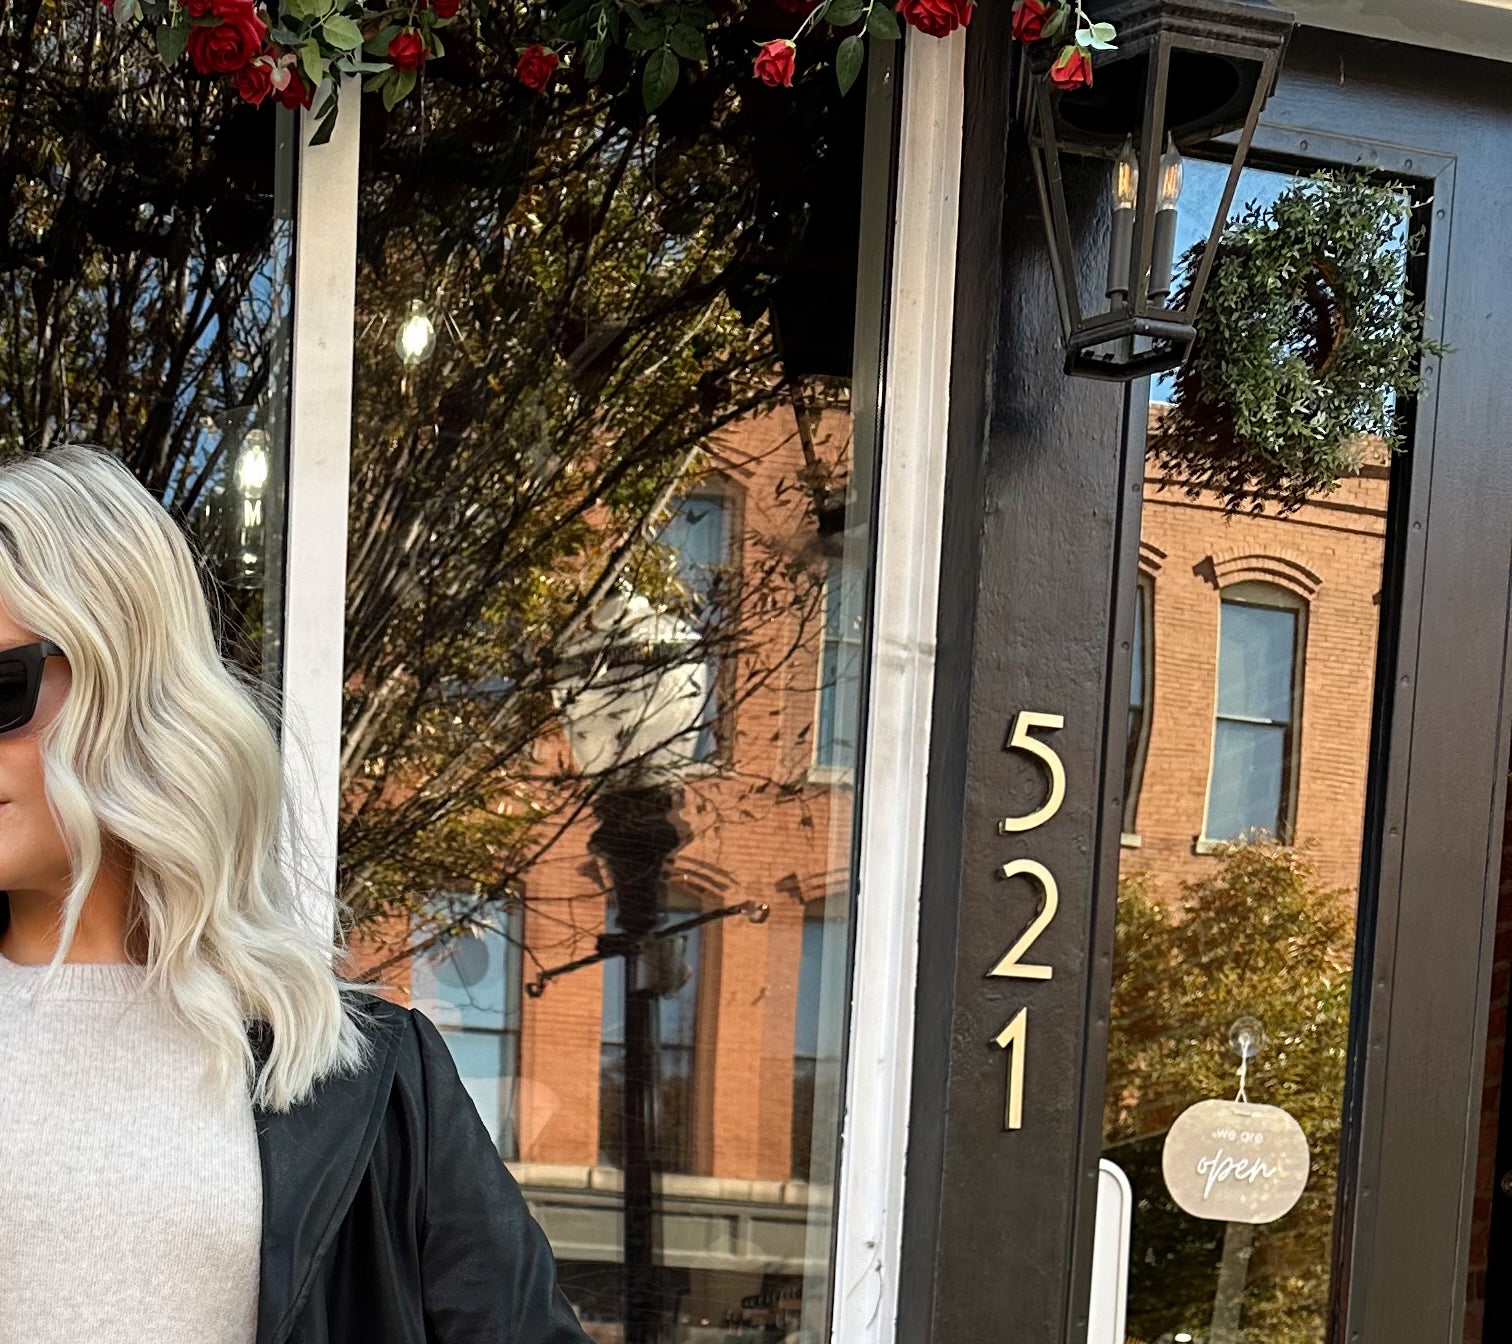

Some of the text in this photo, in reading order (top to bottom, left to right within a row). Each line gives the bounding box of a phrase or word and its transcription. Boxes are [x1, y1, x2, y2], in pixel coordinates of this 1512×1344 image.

[988, 710, 1067, 1130] 521
[1215, 1127, 1264, 1143] we are
[1196, 1147, 1277, 1200] open
